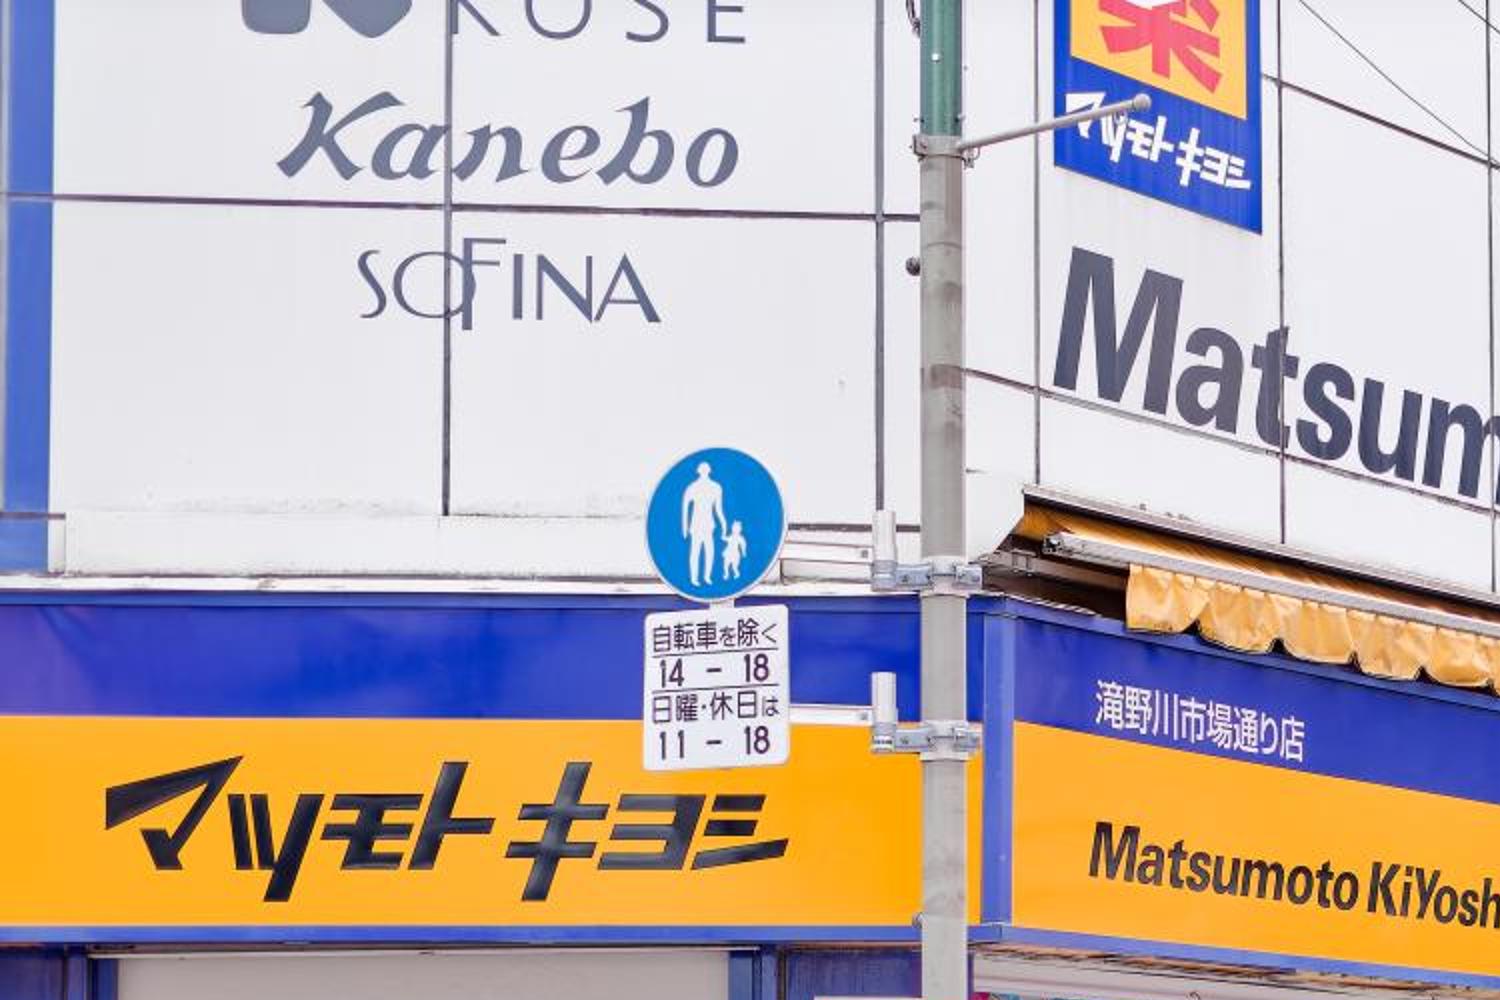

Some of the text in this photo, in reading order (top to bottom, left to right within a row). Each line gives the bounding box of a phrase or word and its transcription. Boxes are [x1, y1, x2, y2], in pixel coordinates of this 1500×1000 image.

[276, 91, 739, 187] Kanebo
[1065, 92, 1251, 190] マツモトキヨシ
[357, 237, 661, 331] SOFINA
[653, 618, 777, 652] 自転車を除く
[659, 658, 685, 688] 14
[744, 653, 769, 683] 18
[659, 729, 685, 760] 11
[744, 725, 770, 755] 18
[1096, 679, 1305, 763] 滝野川市場通り店
[105, 755, 789, 902] マツモトキヨシ
[1089, 821, 1359, 911] Matsumoto
